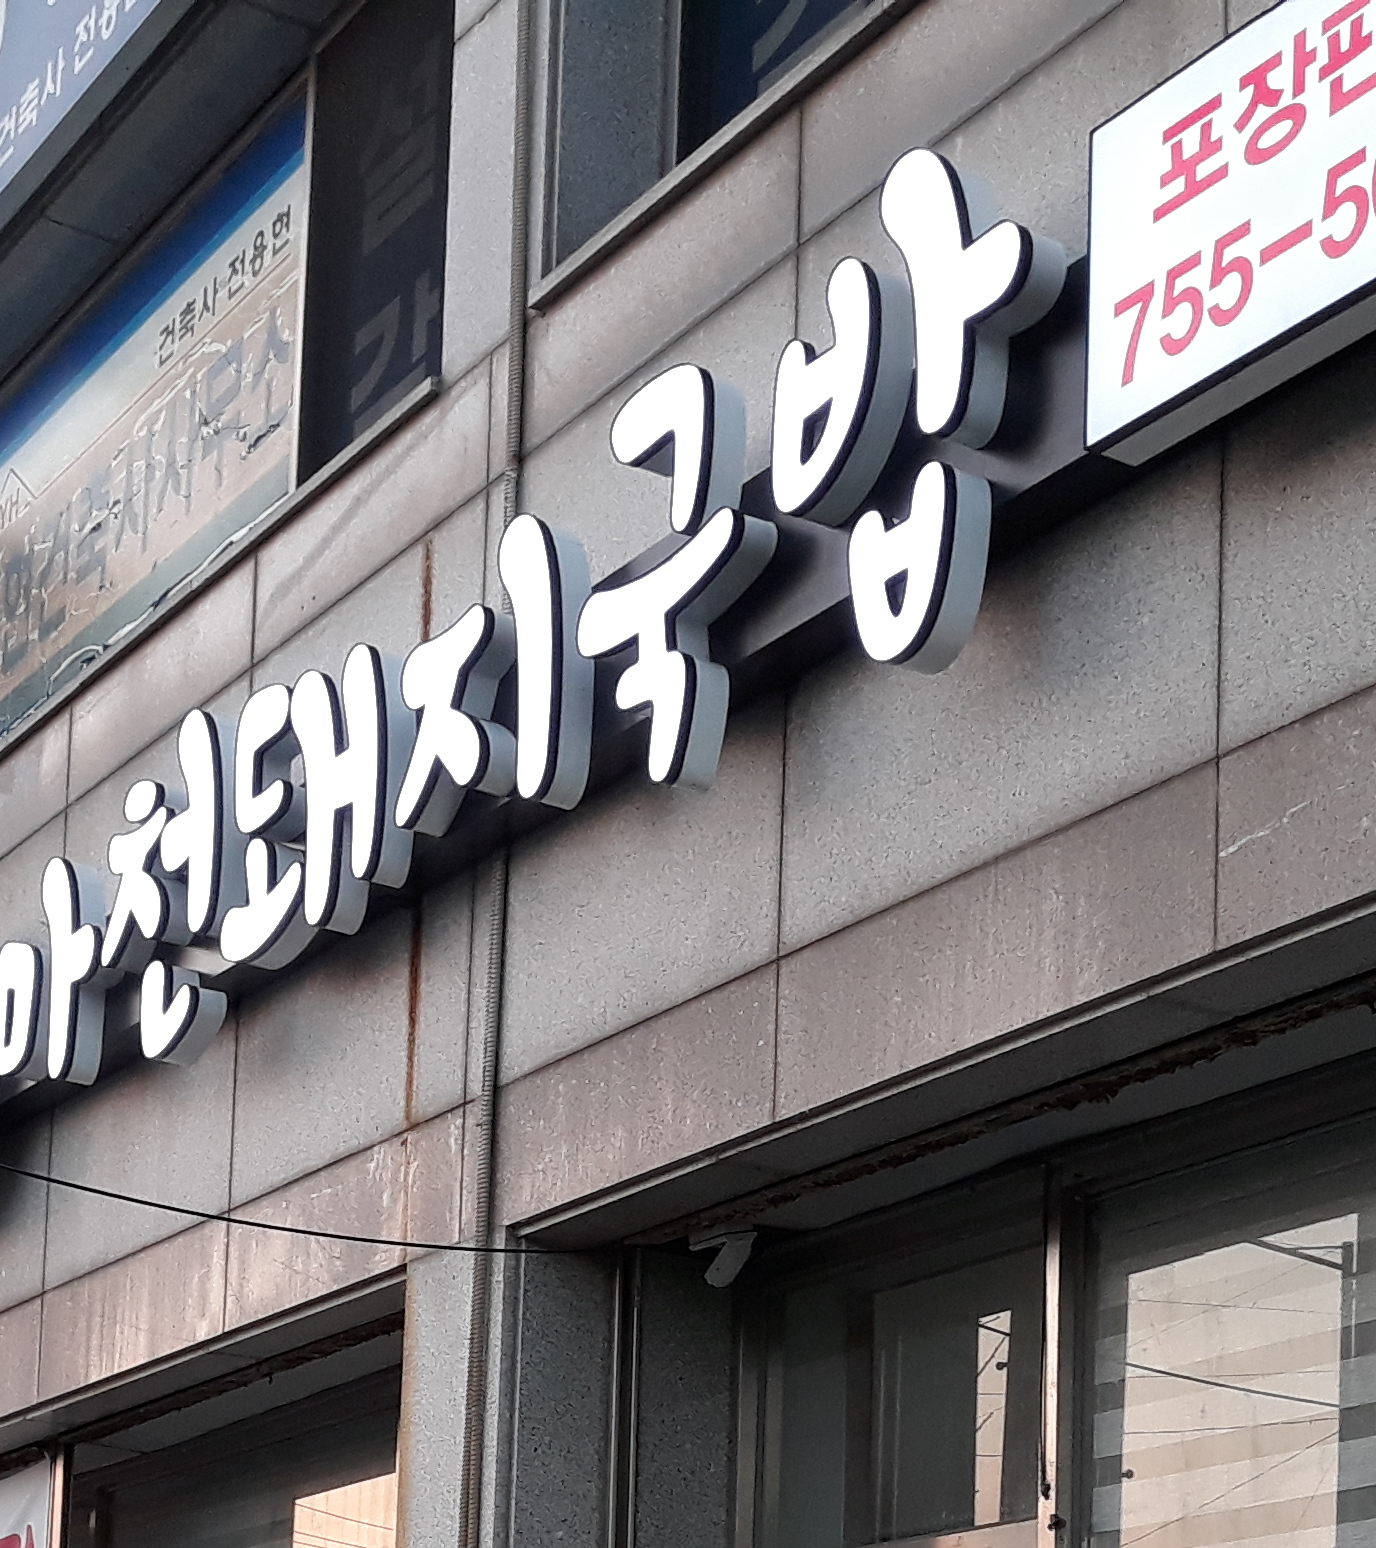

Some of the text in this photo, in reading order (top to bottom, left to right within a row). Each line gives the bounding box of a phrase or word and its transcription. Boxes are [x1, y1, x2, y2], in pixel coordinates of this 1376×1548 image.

[74, 0, 139, 76] 전용
[155, 203, 294, 369] 건축사 전용현
